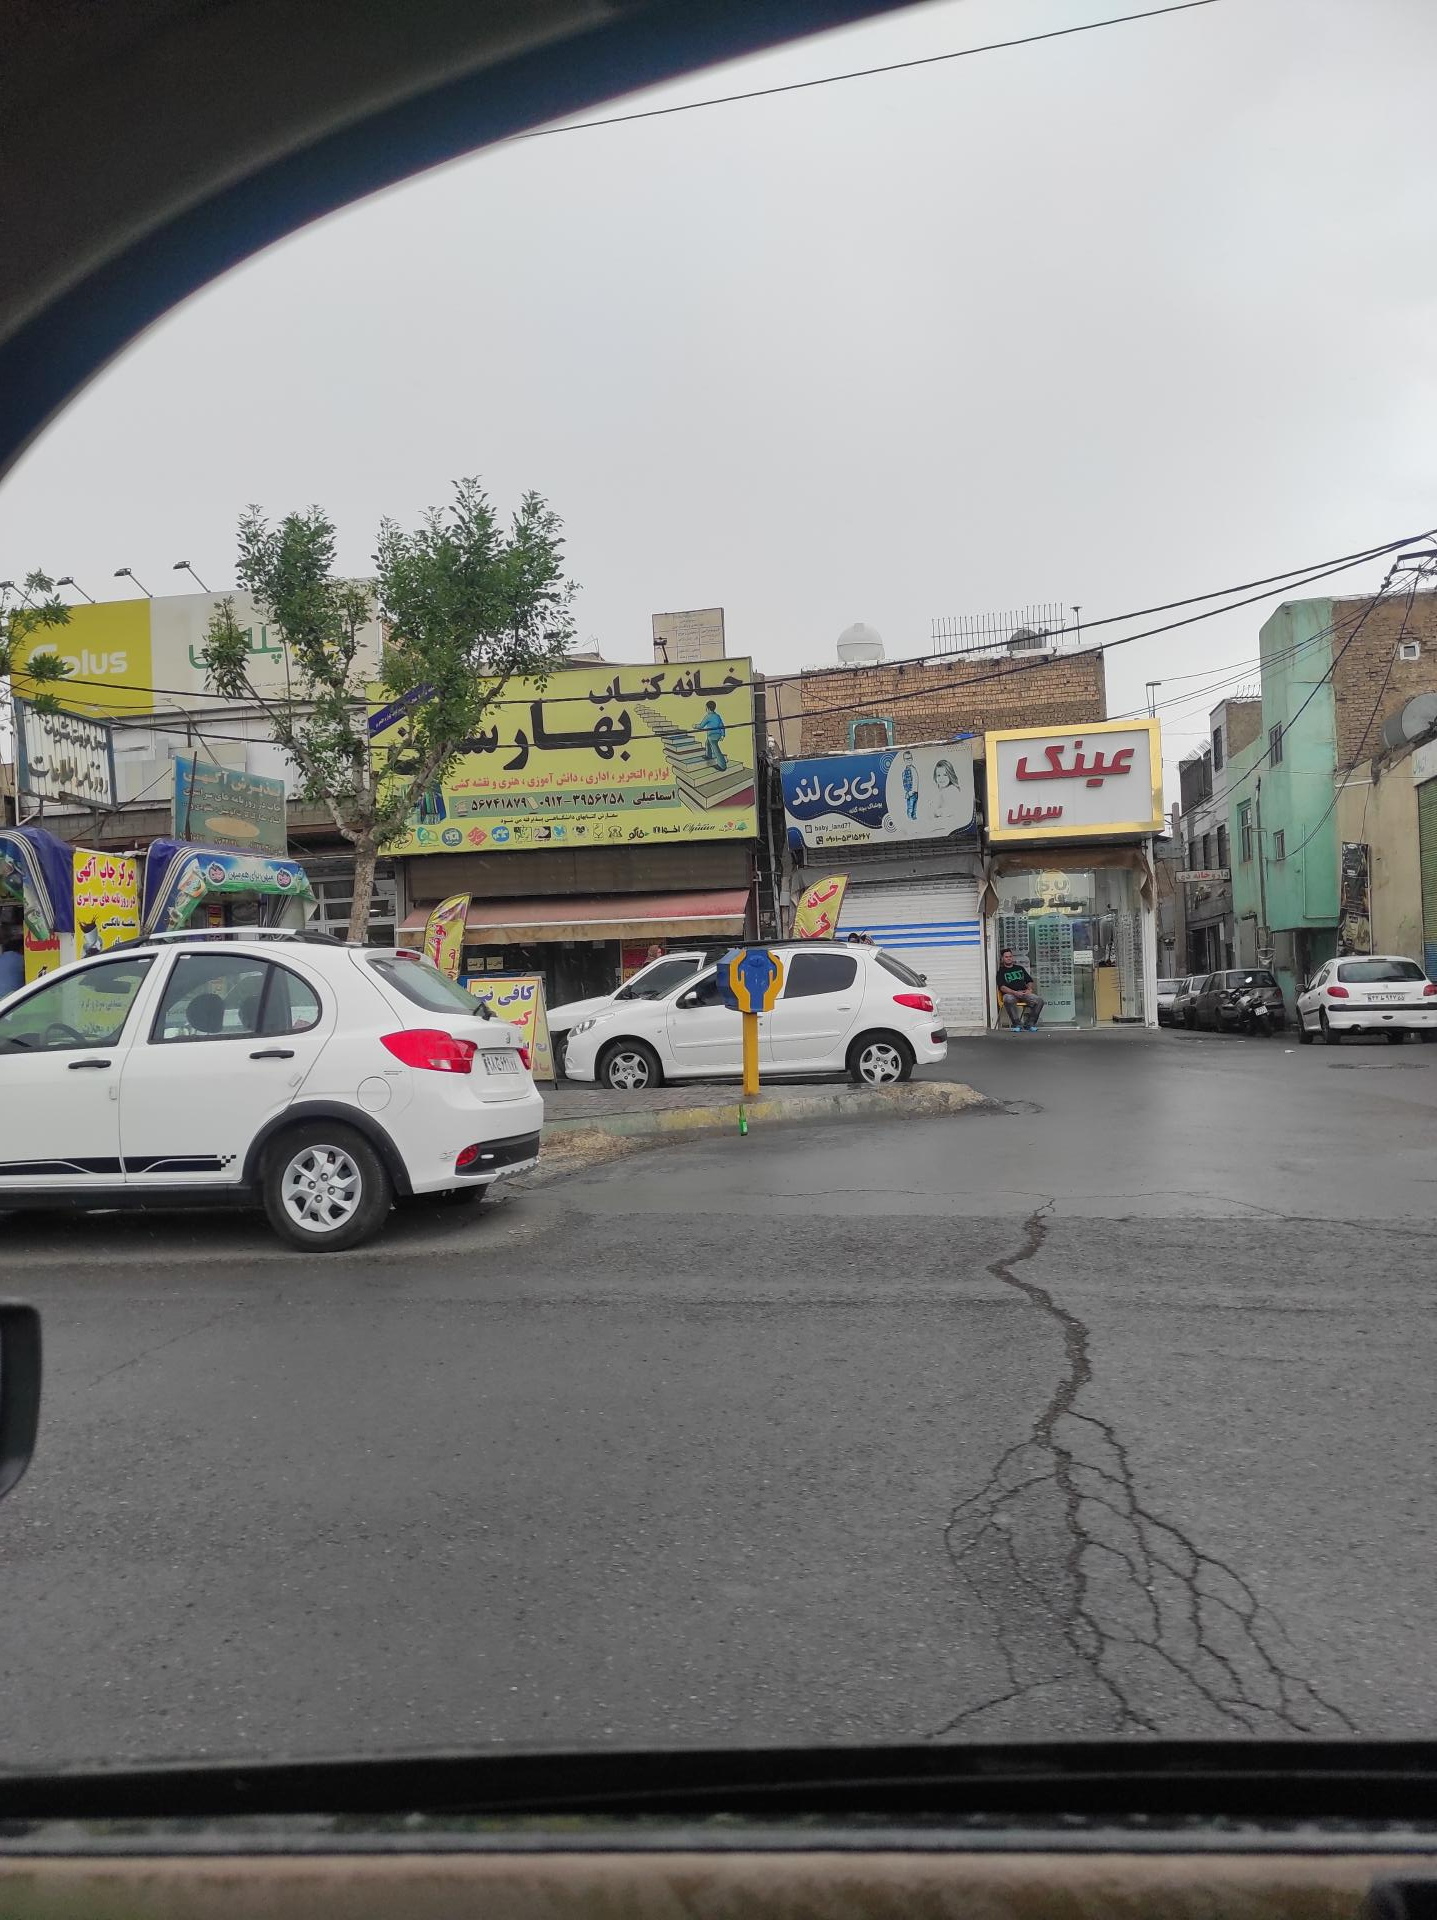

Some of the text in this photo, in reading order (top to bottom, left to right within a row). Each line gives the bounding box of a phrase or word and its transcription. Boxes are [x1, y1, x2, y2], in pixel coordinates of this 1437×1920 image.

[589, 667, 742, 712] خانه کتاب
[648, 767, 669, 782] لوازم
[1016, 740, 1134, 787] عینک
[633, 789, 676, 806] اسماعیلی
[792, 776, 821, 805] لند
[472, 797, 528, 811] ۵۶۷۴۱۸۷۹
[1008, 803, 1063, 825] سهیل
[77, 857, 135, 887] مرکز چاپ آگهی
[77, 892, 99, 906] سراسری
[99, 892, 110, 906] های
[807, 881, 839, 908] خانه
[800, 912, 831, 939] کتا
[498, 984, 536, 1006] کافی
